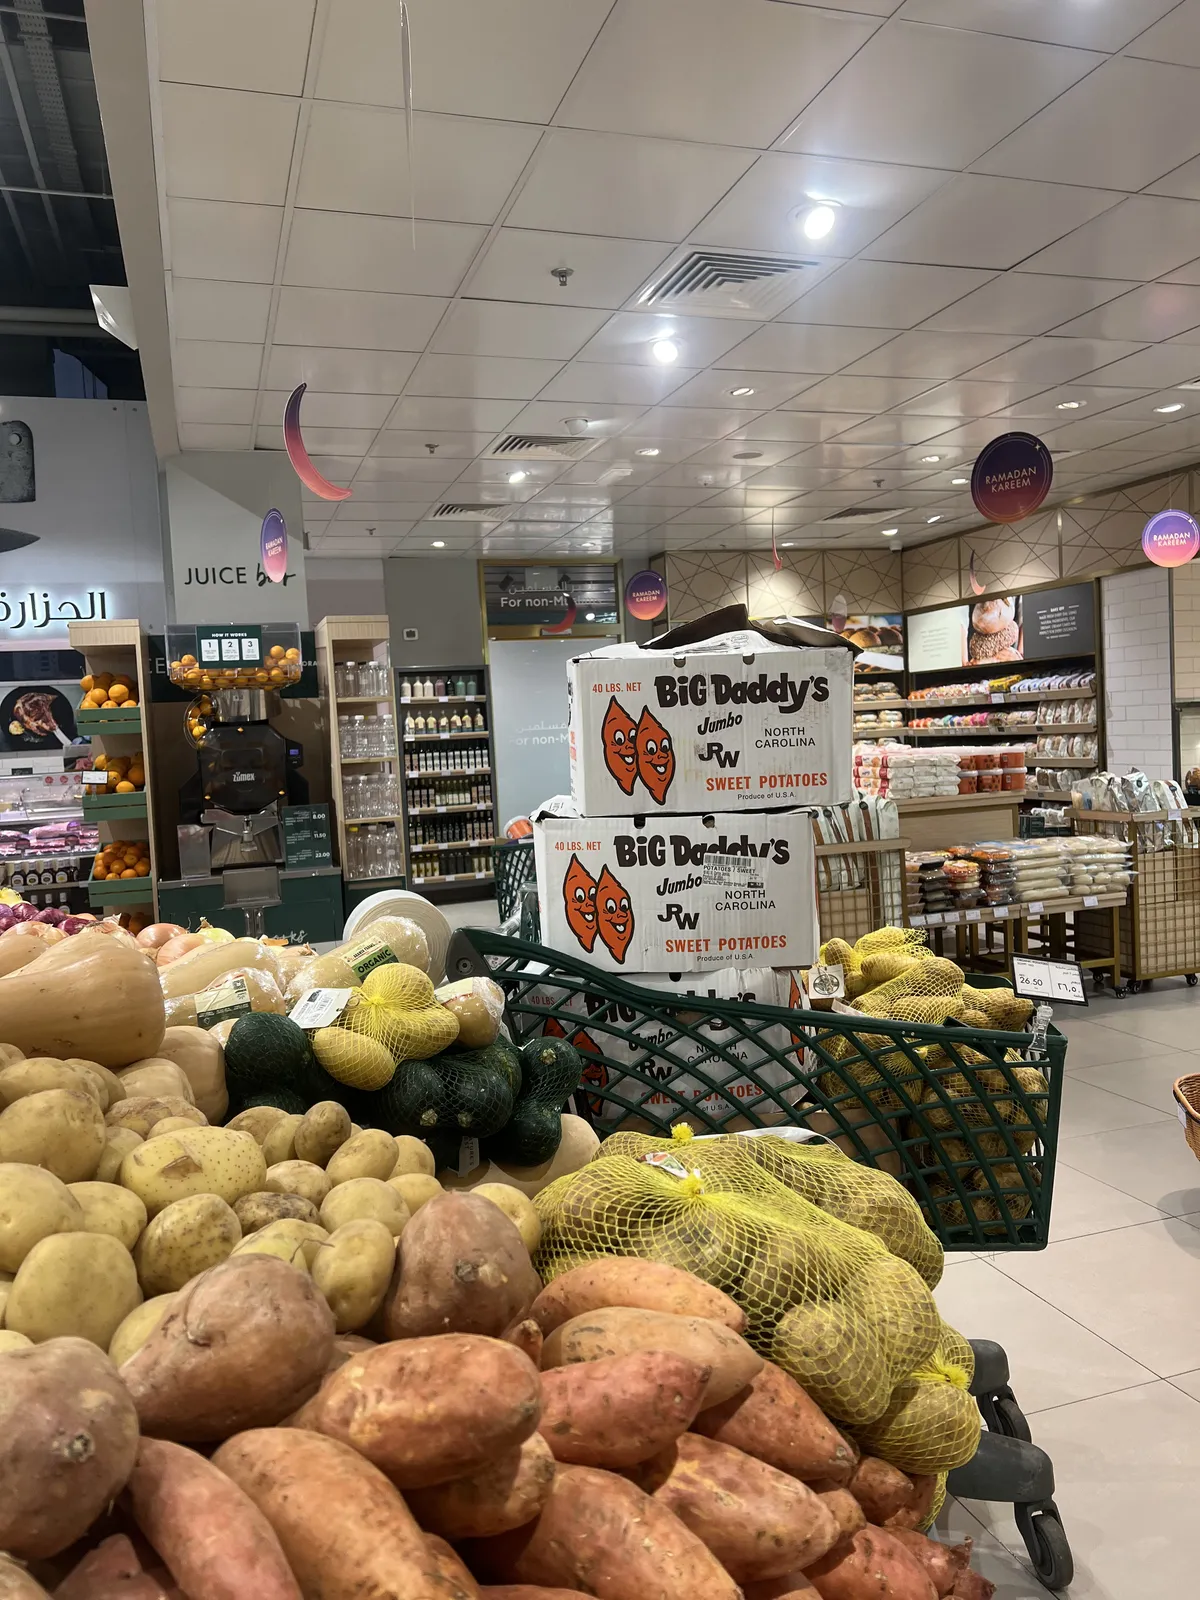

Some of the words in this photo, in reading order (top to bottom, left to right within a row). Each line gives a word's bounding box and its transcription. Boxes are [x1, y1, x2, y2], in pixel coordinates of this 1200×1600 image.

[985, 466, 1037, 485] RAMADAN
[991, 477, 1031, 493] KAREEM
[1153, 531, 1191, 542] RAMADAN
[1157, 538, 1187, 547] KAREEM
[184, 567, 247, 585] JUICE
[632, 589, 660, 598] RAMADAN
[500, 597, 522, 608] For
[592, 683, 603, 693] 40
[604, 682, 624, 693] LBS.
[626, 682, 642, 692] NET
[711, 672, 830, 713] Daddy's
[697, 712, 743, 736] Jumbo
[764, 726, 806, 738] NORTH
[755, 737, 816, 749] CAROLINA
[706, 776, 751, 792] SWEET
[759, 772, 828, 789] POTATOES
[775, 791, 797, 799] U.S.A.
[554, 841, 564, 851] 40
[566, 841, 585, 851] LBS.
[586, 841, 601, 850] NET
[315, 851, 331, 859] 22.00
[704, 864, 732, 872] POTATOES
[656, 873, 702, 896] Jumbo
[725, 889, 766, 900] NORTH
[715, 900, 776, 911] CAROLINA
[665, 938, 710, 953] SWEET
[718, 935, 787, 951] POTATOES
[357, 949, 392, 973] ORGANIC
[734, 953, 755, 961] U.S.A.
[1019, 976, 1043, 986] 26.50
[531, 996, 540, 1005] 40
